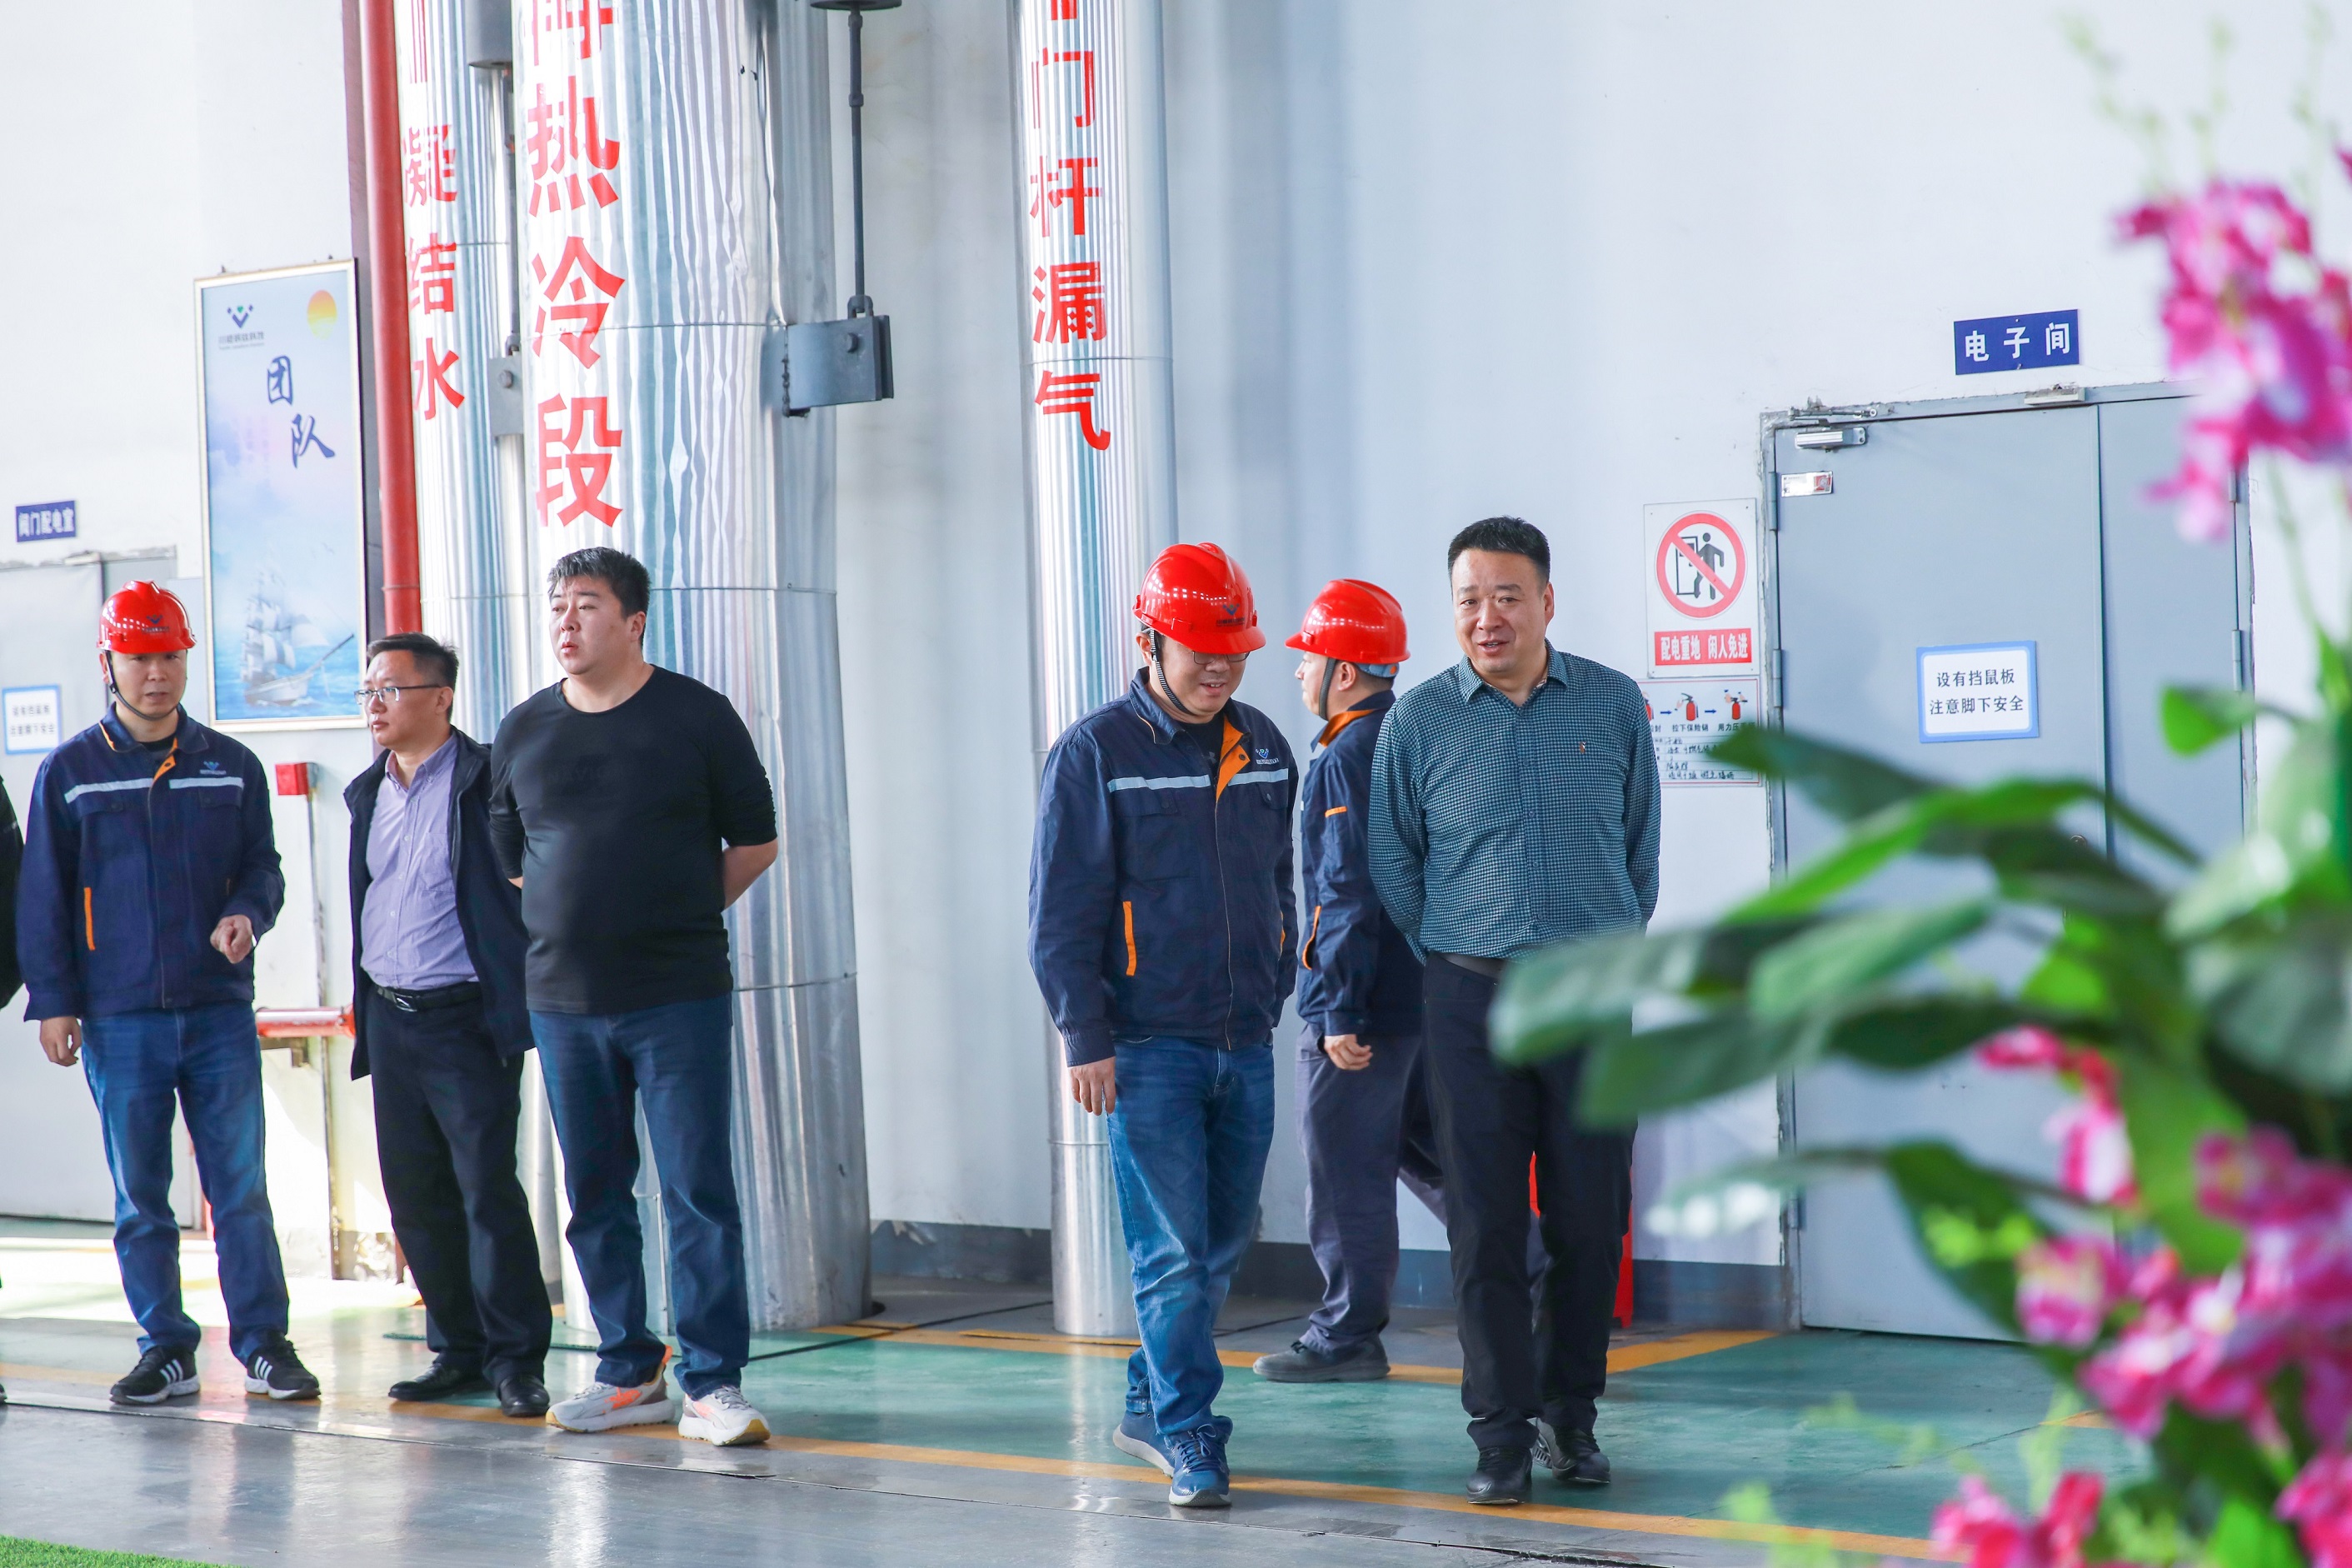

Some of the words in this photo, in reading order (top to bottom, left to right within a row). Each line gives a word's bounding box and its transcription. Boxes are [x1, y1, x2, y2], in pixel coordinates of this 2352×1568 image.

[1030, 47, 1111, 451] 门杆漏气
[1965, 322, 2070, 362] 电子间
[267, 355, 335, 468] 团队
[1660, 635, 1701, 661] 配电重地
[1708, 633, 1748, 659] 闲人免进
[1936, 668, 2015, 688] 设有挡鼠板
[1930, 695, 2024, 715] 注意脚下安全
